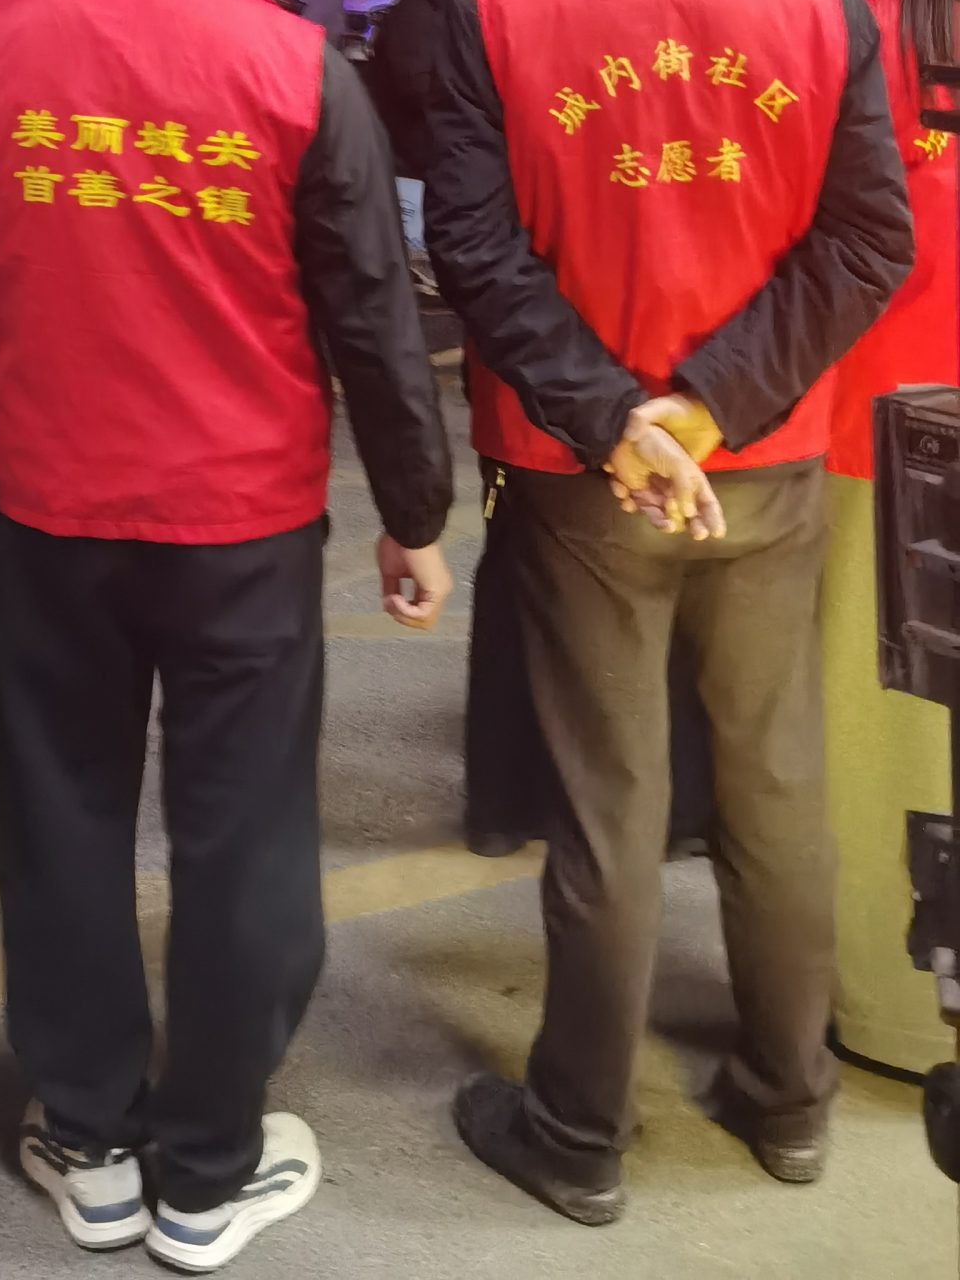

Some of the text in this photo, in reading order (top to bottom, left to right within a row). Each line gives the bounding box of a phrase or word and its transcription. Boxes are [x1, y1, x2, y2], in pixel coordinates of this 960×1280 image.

[549, 38, 799, 135] 城内街社区
[11, 109, 262, 171] 美丽城关
[609, 137, 748, 187] 志愿者
[13, 165, 256, 226] 首善之镇
